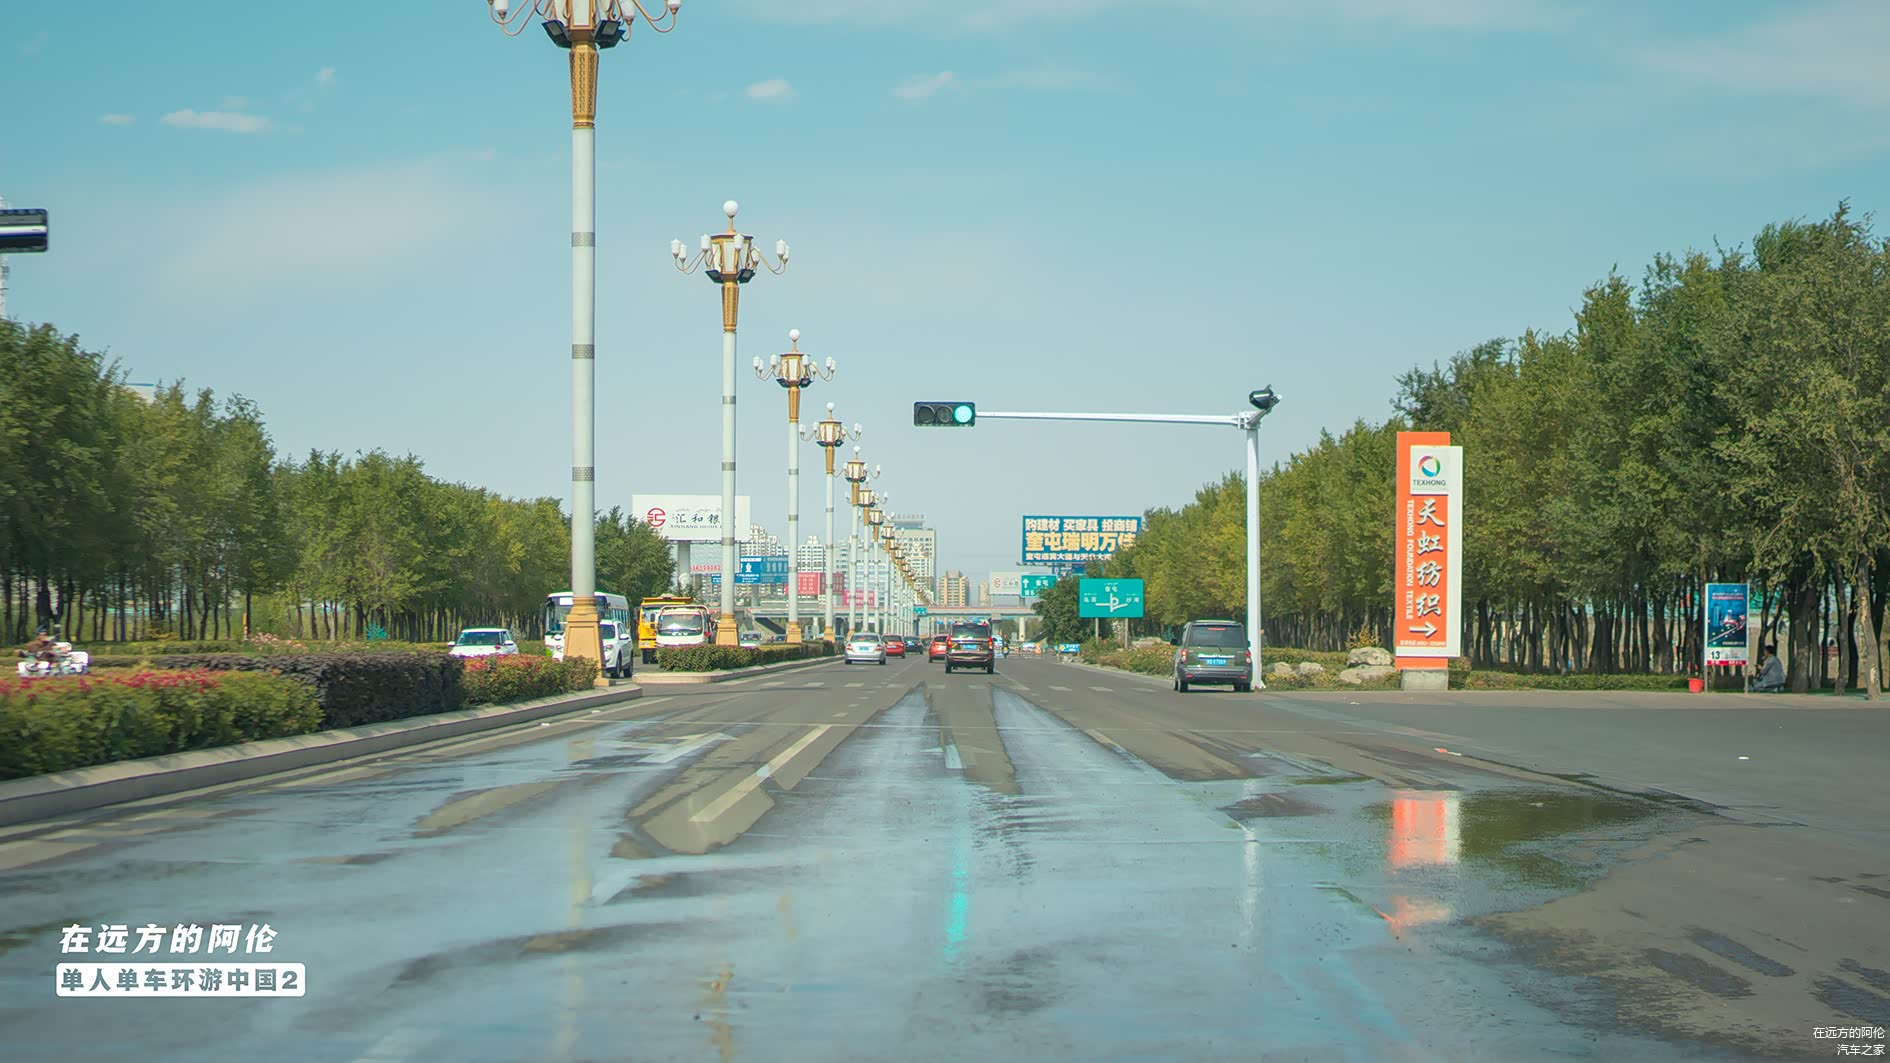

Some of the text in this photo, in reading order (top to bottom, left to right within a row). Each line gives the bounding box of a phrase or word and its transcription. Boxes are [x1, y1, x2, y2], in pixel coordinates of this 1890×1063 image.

[1025, 518, 1060, 531] 购建材
[1063, 519, 1098, 531] 买家具
[1406, 539, 1414, 587] FOUNDATION
[1416, 498, 1445, 619] 天虹纺织
[1405, 590, 1413, 620] TEXTILE
